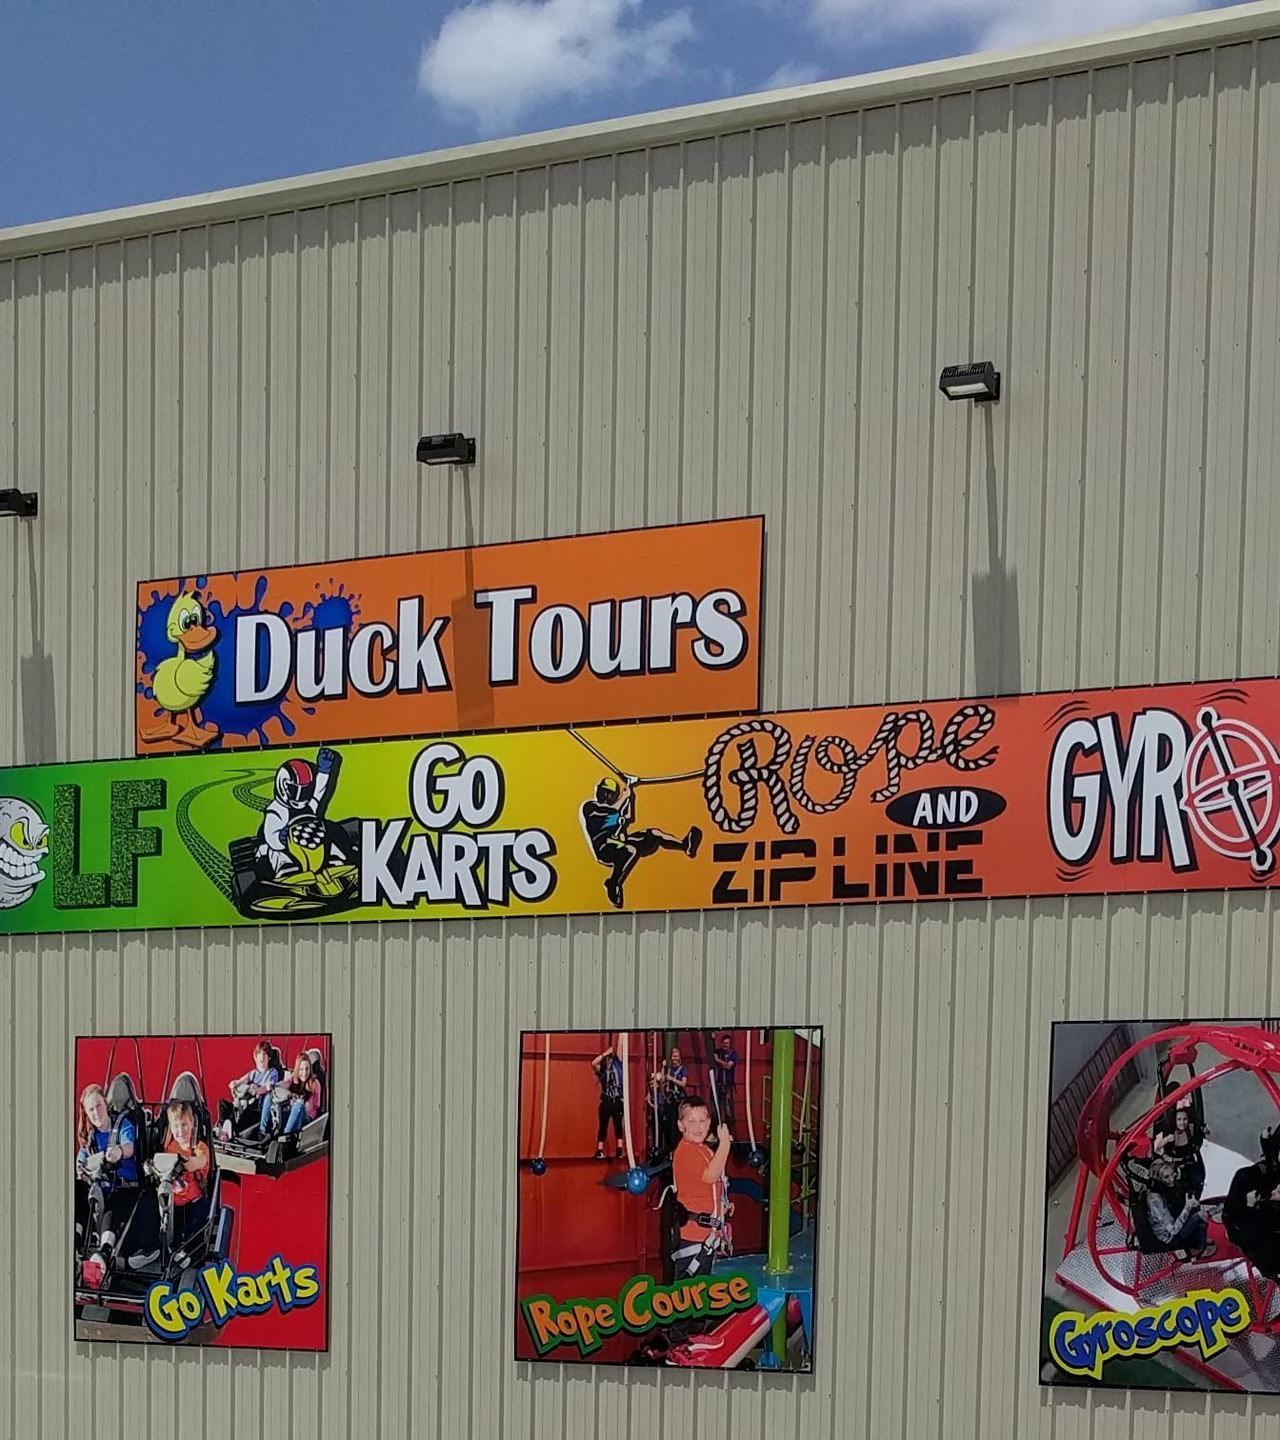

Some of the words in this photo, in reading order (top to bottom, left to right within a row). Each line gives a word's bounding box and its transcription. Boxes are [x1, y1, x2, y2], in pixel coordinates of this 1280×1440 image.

[233, 595, 451, 706] Duck
[475, 586, 747, 684] Tours
[703, 704, 1000, 834] Rope
[912, 789, 979, 827] AND
[362, 818, 558, 909] KARTS
[711, 838, 817, 904] ZIP
[832, 829, 984, 899] LINE
[148, 1283, 202, 1333] Go
[202, 1255, 319, 1319] Karts
[528, 1299, 616, 1346] Rope
[623, 1276, 751, 1326] Course
[1053, 1294, 1246, 1368] Gyroscope
